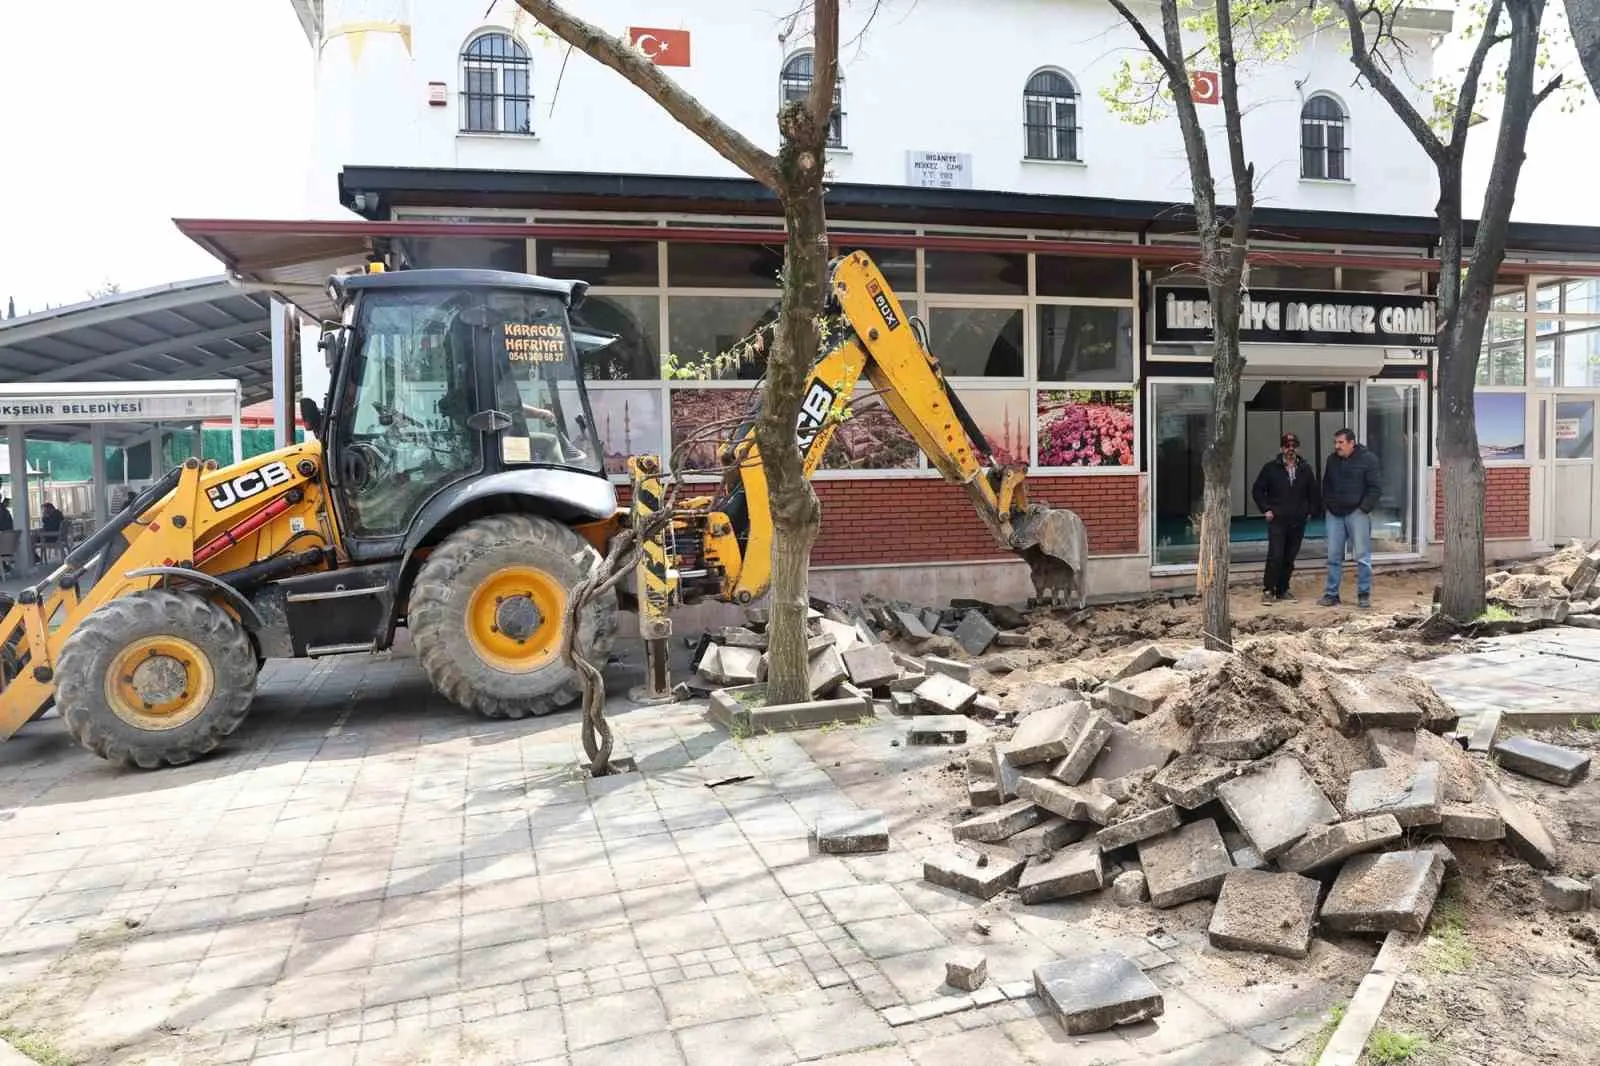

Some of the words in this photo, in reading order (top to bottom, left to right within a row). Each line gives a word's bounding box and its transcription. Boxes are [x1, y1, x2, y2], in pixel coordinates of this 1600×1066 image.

[1286, 302, 1375, 333] MERKEZ
[504, 323, 562, 336] KARAGÖZ
[505, 337, 564, 351] HAFRİYAT
[0, 403, 54, 416] KŞEHİR
[62, 399, 142, 414] BELEDİYESİ
[207, 460, 293, 510] JCB
